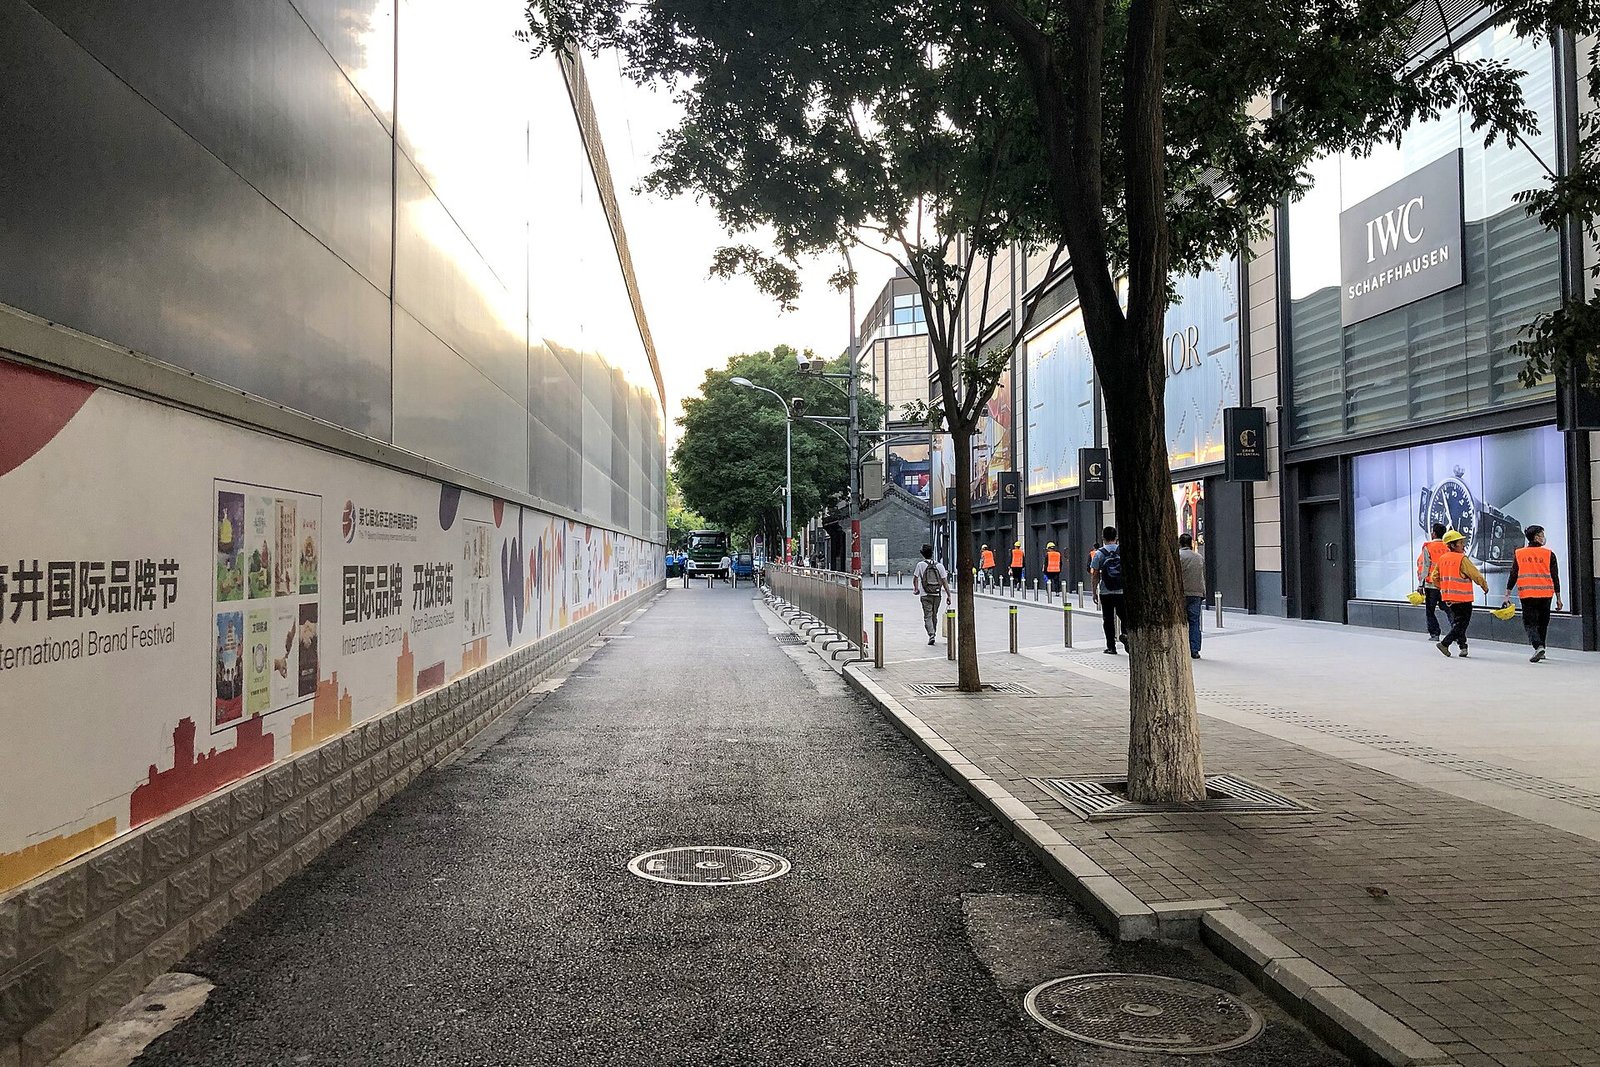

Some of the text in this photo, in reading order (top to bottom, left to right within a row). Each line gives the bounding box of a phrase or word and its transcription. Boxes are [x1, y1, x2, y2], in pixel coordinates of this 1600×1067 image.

[1365, 195, 1424, 264] IWC
[1348, 245, 1449, 299] SCHAFFHAUSEN
[1163, 325, 1202, 378] IOR
[343, 562, 453, 625] 国际品牌 开放商街
[88, 627, 128, 656] Brand
[132, 622, 175, 648] Festival
[342, 624, 402, 656] International Brand
[411, 615, 423, 637] Open
